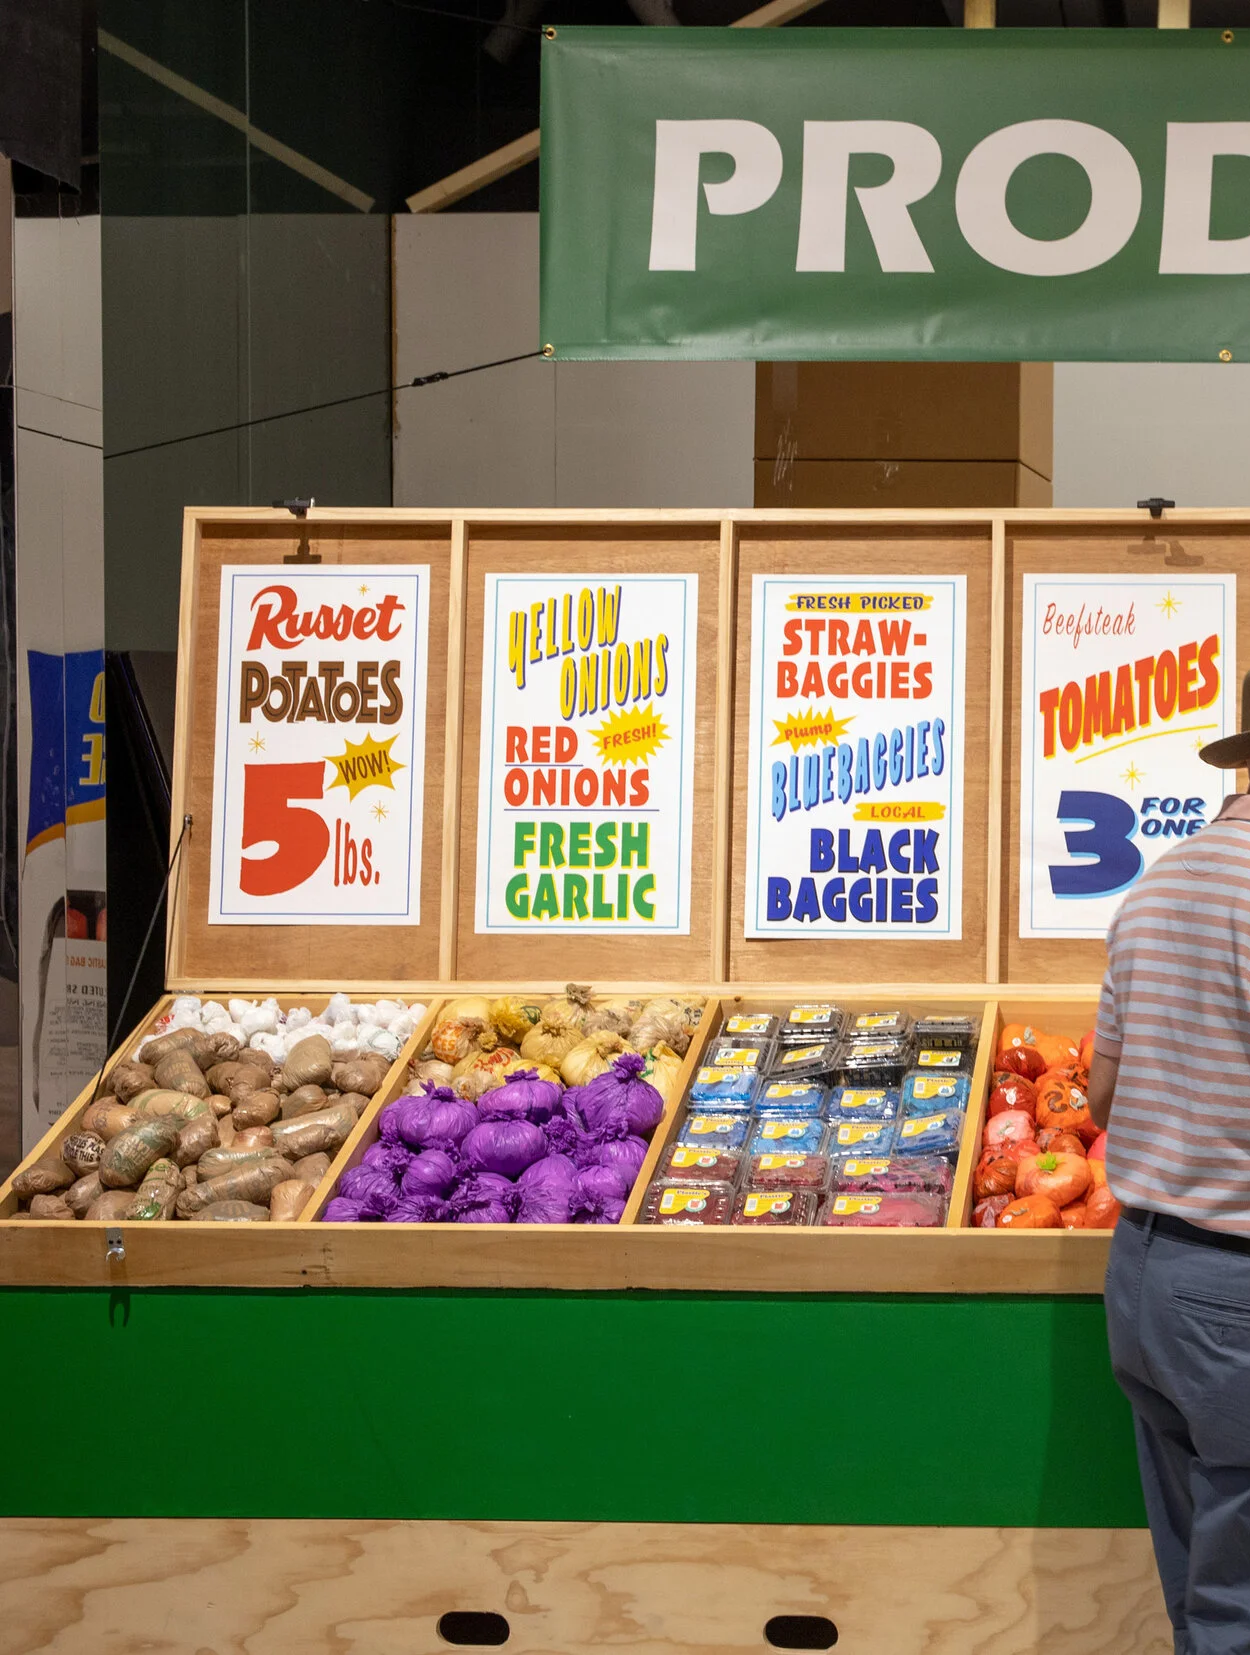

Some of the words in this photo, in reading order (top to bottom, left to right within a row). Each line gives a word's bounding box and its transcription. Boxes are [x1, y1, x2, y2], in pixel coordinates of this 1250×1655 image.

[246, 585, 406, 652] Russet
[796, 596, 851, 610] FRESH
[860, 596, 924, 610] PICKED
[1042, 601, 1136, 649] Beefsteak
[509, 585, 622, 690] YELLOW
[782, 618, 927, 656] STRAW-
[239, 660, 404, 725] POTATOES
[560, 633, 669, 721] ONIONS
[777, 661, 933, 699] BAGGIES
[1039, 634, 1220, 760] TOMATOES
[505, 726, 579, 764] RED
[603, 723, 657, 750] FRESH!
[339, 750, 391, 784] WOW!
[504, 768, 650, 807] ONIONS
[771, 718, 946, 822] BLUEBAGGIES
[239, 761, 330, 896] 5
[334, 818, 380, 887] lbs.
[871, 806, 926, 819] LOCAL
[1140, 797, 1207, 817] FOR
[1141, 819, 1206, 839] ONE
[513, 821, 651, 870] FRESH
[810, 828, 940, 874] BLACK
[1048, 790, 1145, 900] 3
[505, 873, 656, 922] GARLIC
[767, 877, 939, 923] BAGGIES
